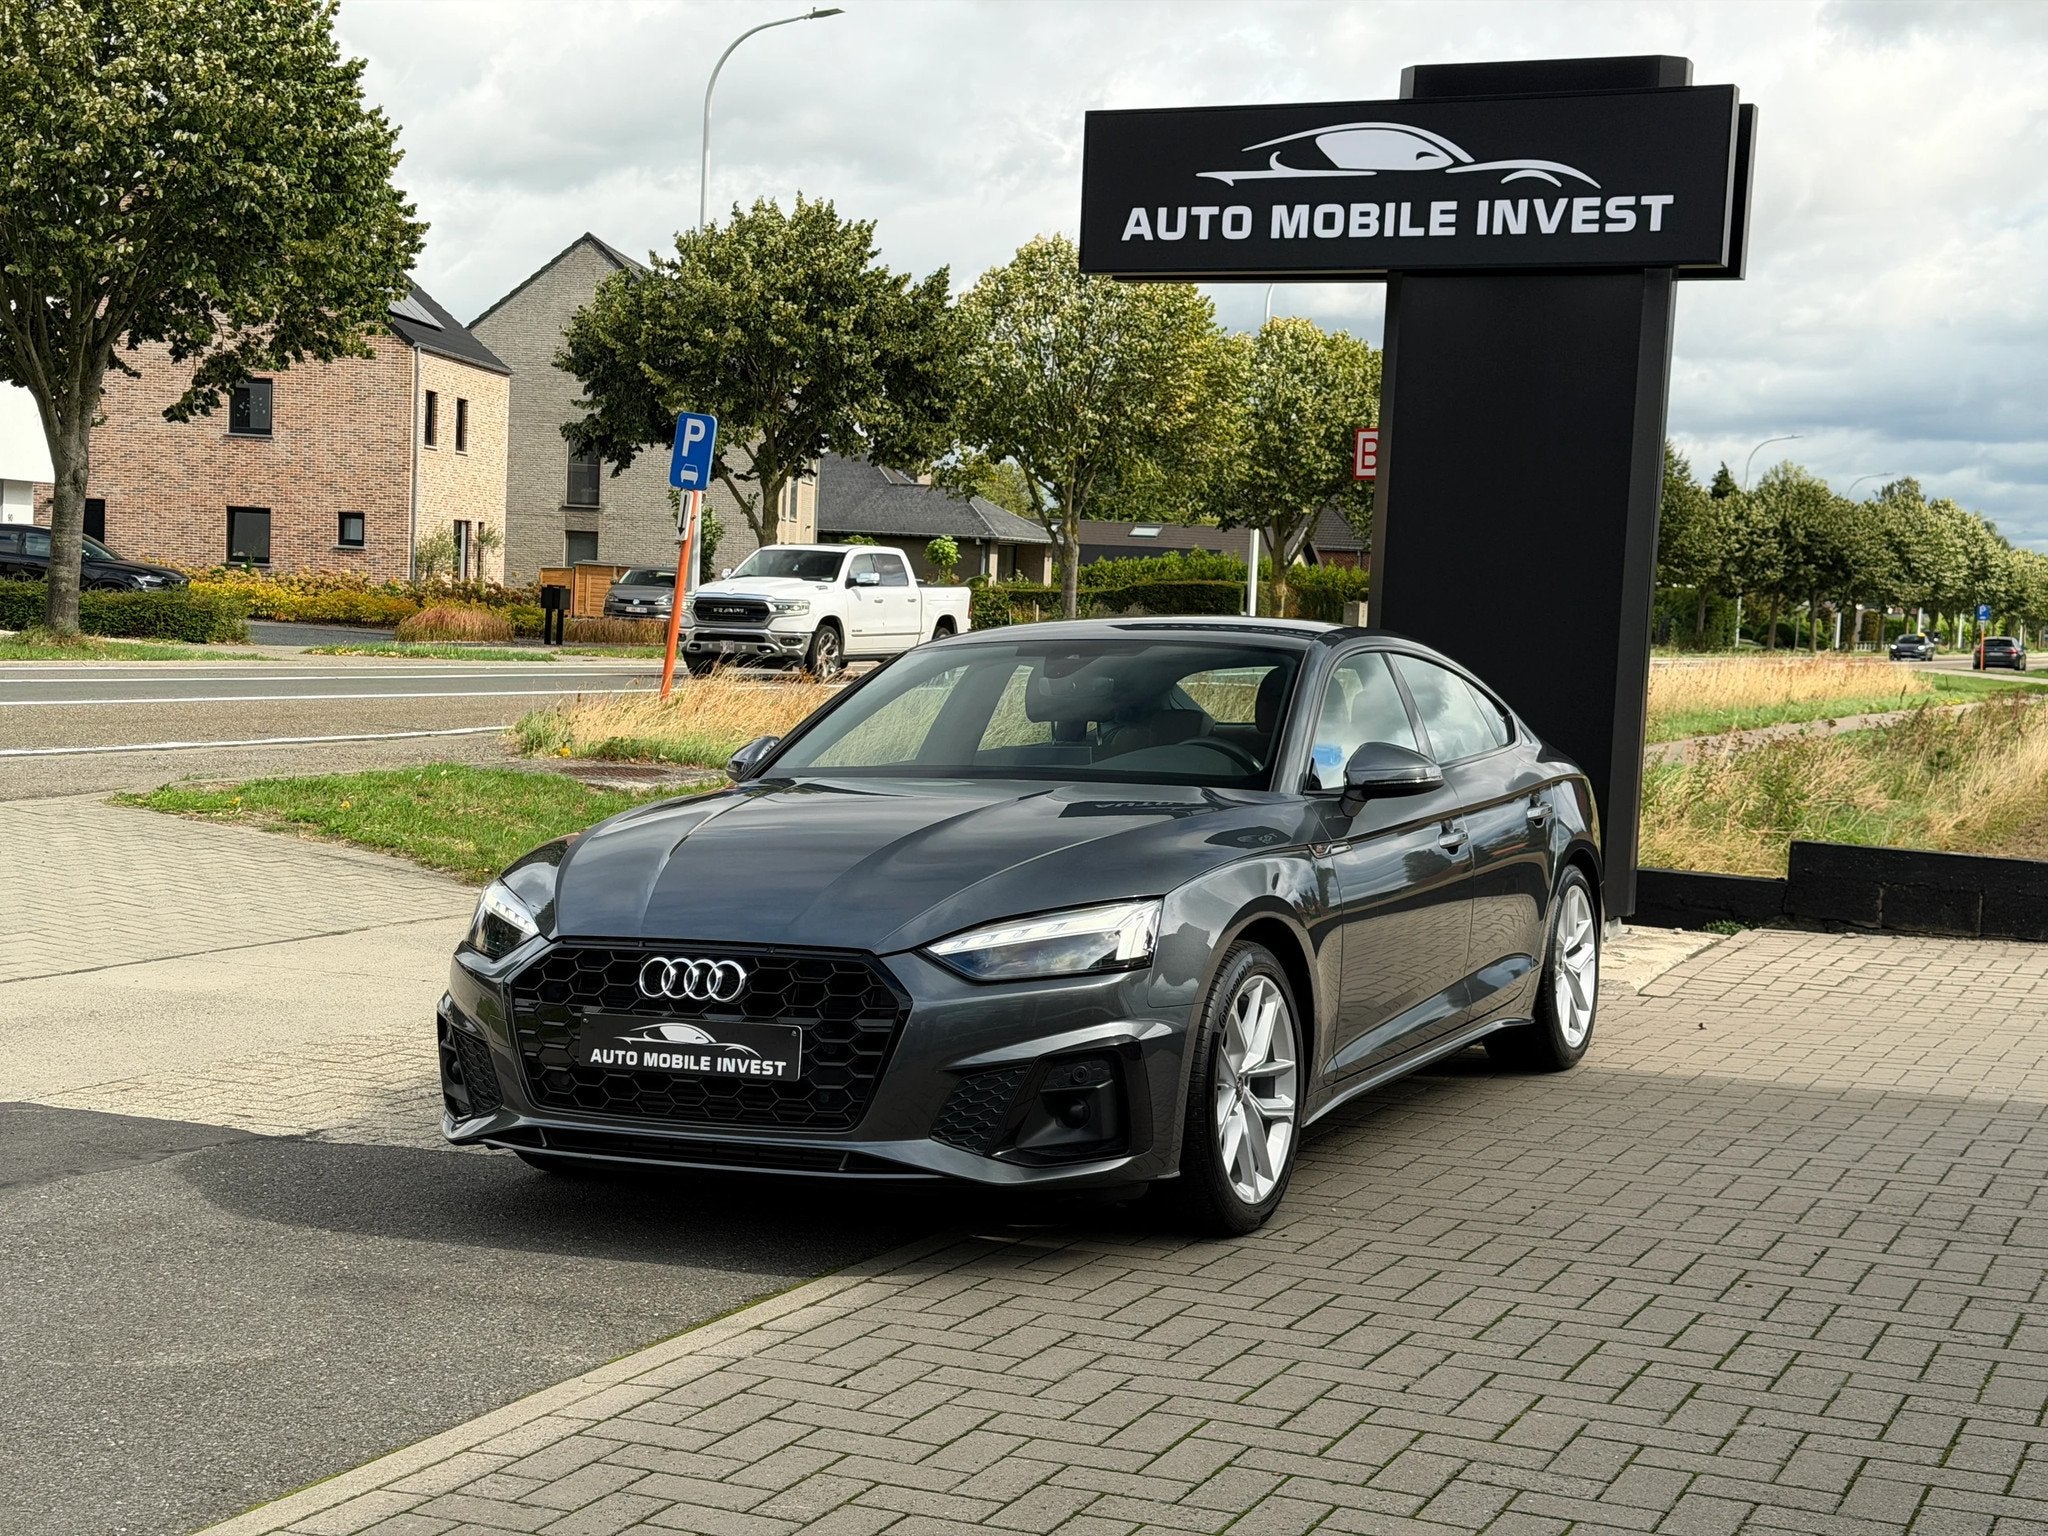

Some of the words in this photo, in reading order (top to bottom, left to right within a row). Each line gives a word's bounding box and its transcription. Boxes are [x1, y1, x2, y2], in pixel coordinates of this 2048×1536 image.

[1121, 205, 1253, 241] AUTO
[1270, 200, 1458, 240] MOBILE
[1476, 194, 1675, 236] INVEST
[681, 418, 706, 457] P
[590, 1048, 638, 1066] AUTO
[643, 1051, 711, 1071] MOBILE
[716, 1057, 787, 1076] INVEST
